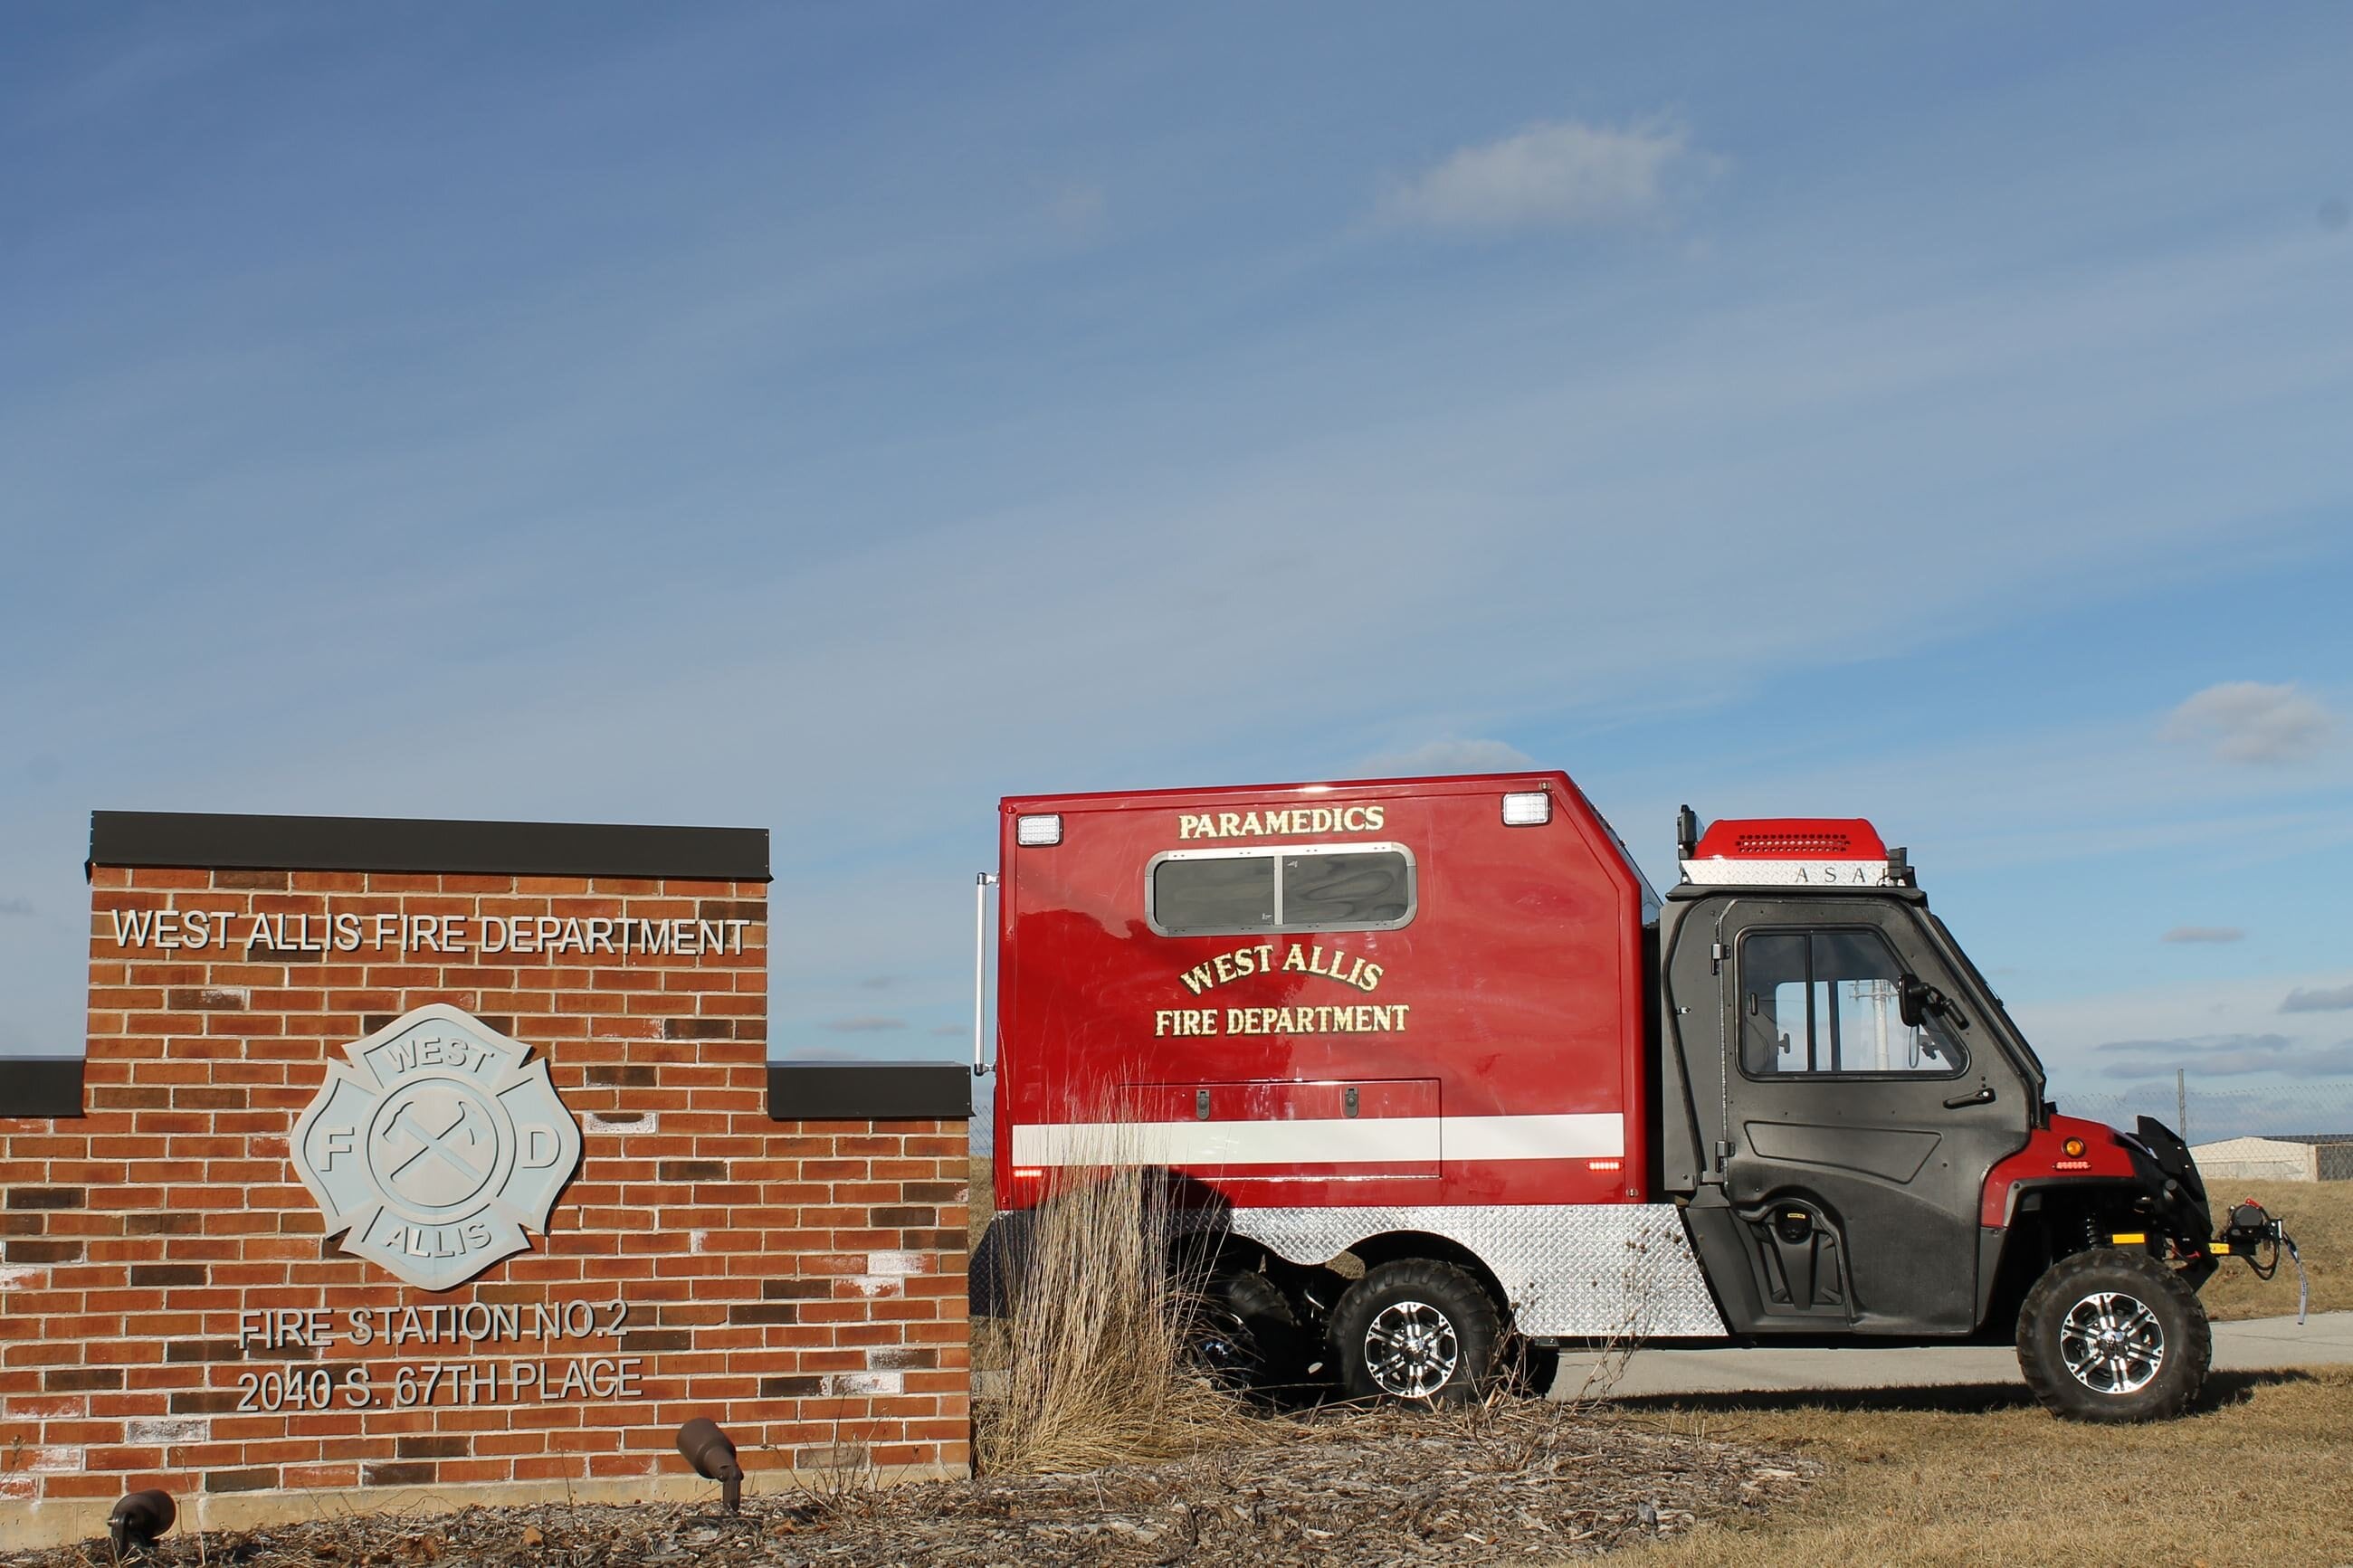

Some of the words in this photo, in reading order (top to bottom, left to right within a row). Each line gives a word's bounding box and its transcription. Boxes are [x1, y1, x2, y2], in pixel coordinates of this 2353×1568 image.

[1178, 805, 1385, 840] PARAMEDICS
[111, 908, 238, 950] WEST
[246, 912, 362, 952] ALLIS
[375, 914, 468, 955] FIRE
[481, 915, 751, 957] DEPARTMENT
[1179, 944, 1274, 996] WEST
[1281, 944, 1385, 993] ALLIS
[1154, 1009, 1219, 1037] FIRE
[1226, 1004, 1410, 1036] DEPARTMENT
[383, 1037, 496, 1074] WEST
[319, 1126, 355, 1173] F
[521, 1126, 562, 1170] D
[381, 1222, 492, 1259] ALLIS
[239, 1308, 334, 1350] FIRE
[347, 1302, 523, 1346] STATION
[236, 1369, 333, 1412] 2040
[345, 1368, 383, 1408] S.
[395, 1364, 498, 1407] 67TH
[512, 1358, 643, 1402] PLACE
